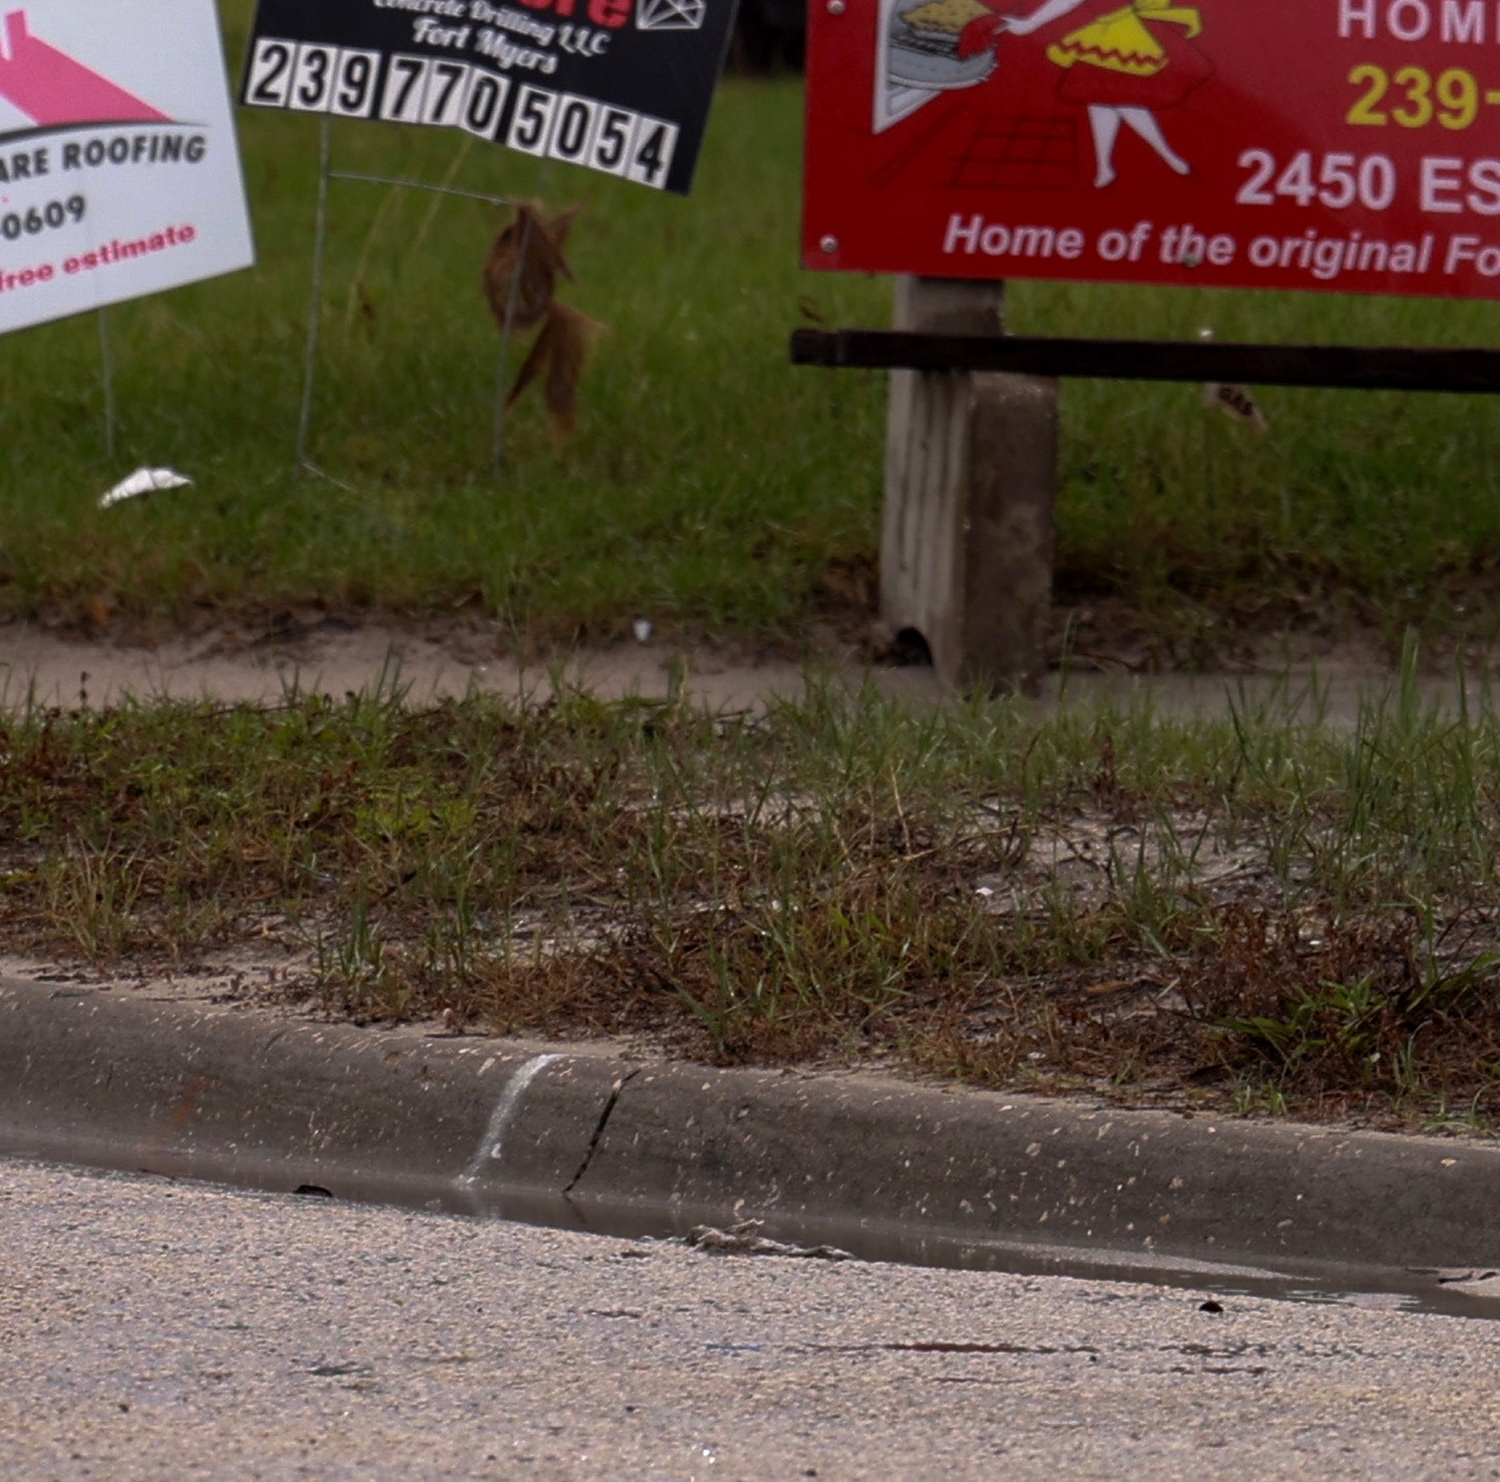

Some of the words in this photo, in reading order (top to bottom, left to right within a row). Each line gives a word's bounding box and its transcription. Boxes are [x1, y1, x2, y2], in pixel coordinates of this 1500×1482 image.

[412, 16, 470, 49] Fort
[474, 27, 558, 75] Myers
[556, 23, 612, 58] LLC
[256, 42, 371, 112] 239
[390, 57, 502, 134] 770
[515, 88, 666, 182] 5054
[61, 134, 207, 171] ROOFING
[1234, 148, 1396, 212] 2450
[62, 222, 197, 275] estimate
[941, 213, 1085, 261] Home
[1099, 221, 1143, 264] of
[1159, 225, 1236, 267] the
[1248, 229, 1432, 281] original
